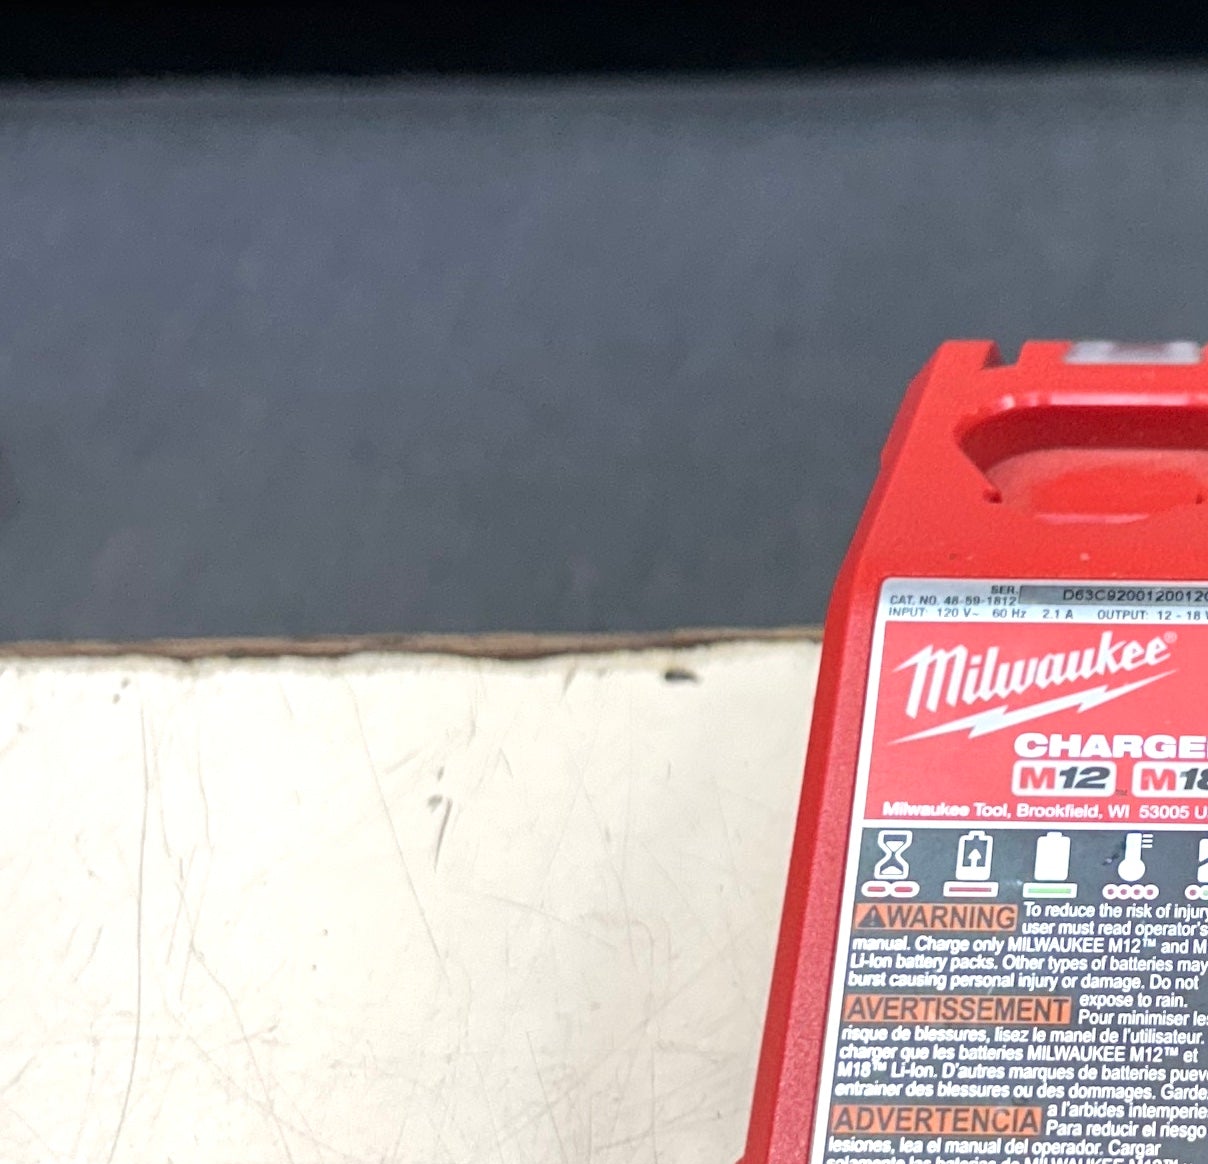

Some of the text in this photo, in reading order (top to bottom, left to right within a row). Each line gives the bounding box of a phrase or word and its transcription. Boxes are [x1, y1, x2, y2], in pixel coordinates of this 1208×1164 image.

[937, 609, 958, 617] 120
[992, 609, 1007, 618] 60
[1012, 609, 1026, 618] Hz
[1042, 610, 1059, 619] 2.1
[1065, 610, 1073, 619] A
[1158, 611, 1171, 620] 12
[1187, 611, 1200, 620] 18
[883, 802, 969, 817] Milwaukee
[974, 803, 1011, 819] Tool,
[1016, 804, 1102, 820] Brookfield,
[1108, 805, 1130, 818] WI
[1140, 805, 1189, 819] 53005
[887, 906, 1016, 928] WARNING
[1024, 902, 1041, 916] To
[1045, 903, 1095, 917] reduce
[1099, 903, 1122, 917] the
[1126, 904, 1152, 918] risk
[1156, 903, 1171, 918] of
[1022, 922, 1055, 934] user
[1059, 922, 1094, 935] must
[1098, 923, 1131, 935] read
[852, 936, 910, 950] manual.
[915, 936, 970, 954] Charge
[973, 937, 1004, 954] only
[1008, 937, 1104, 952] MILWAUKEE
[1161, 939, 1188, 953] and
[895, 954, 947, 972] battery
[950, 955, 997, 972] packs.
[1002, 954, 1049, 970] Other
[1048, 956, 1087, 973] types
[1091, 955, 1106, 971] of
[1110, 956, 1173, 971] batteries
[1177, 960, 1208, 976] may
[848, 971, 1198, 992] burst causing personal injury or damage. Do not
[847, 997, 1069, 1022] AVERTISSEMENT
[1080, 993, 1187, 1010] expose to rain.
[1079, 1010, 1112, 1024] Pour
[1118, 1011, 1189, 1026] minimiser
[842, 1025, 888, 1043] risque
[892, 1026, 911, 1041] de
[915, 1026, 990, 1044] blessures,
[994, 1027, 1028, 1042] lisez
[1032, 1027, 1046, 1042] le
[1100, 1029, 1119, 1043] de
[839, 1044, 898, 1062] charger
[900, 1047, 929, 1063] que
[933, 1045, 955, 1060] les
[959, 1045, 1023, 1060] batteries
[1027, 1045, 1125, 1061] MILWAUKEE
[1183, 1048, 1198, 1063] et
[1009, 1066, 1074, 1083] marques
[1078, 1065, 1097, 1080] de
[1102, 1065, 1166, 1081] batteries
[905, 1082, 933, 1097] des
[937, 1082, 1010, 1098] blessures
[1013, 1085, 1032, 1098] ou
[1037, 1084, 1064, 1099] des
[1069, 1084, 1155, 1103] dommages.
[833, 1107, 1038, 1133] ADVERTENCIA
[1046, 1120, 1082, 1135] Para
[1086, 1121, 1139, 1136] reducir
[1142, 1122, 1156, 1137] el
[829, 1136, 895, 1154] lesiones,
[900, 1137, 923, 1152] lea
[927, 1138, 941, 1153] el
[945, 1138, 1001, 1153] manual
[1005, 1139, 1027, 1154] del
[1108, 1140, 1161, 1158] Cargar
